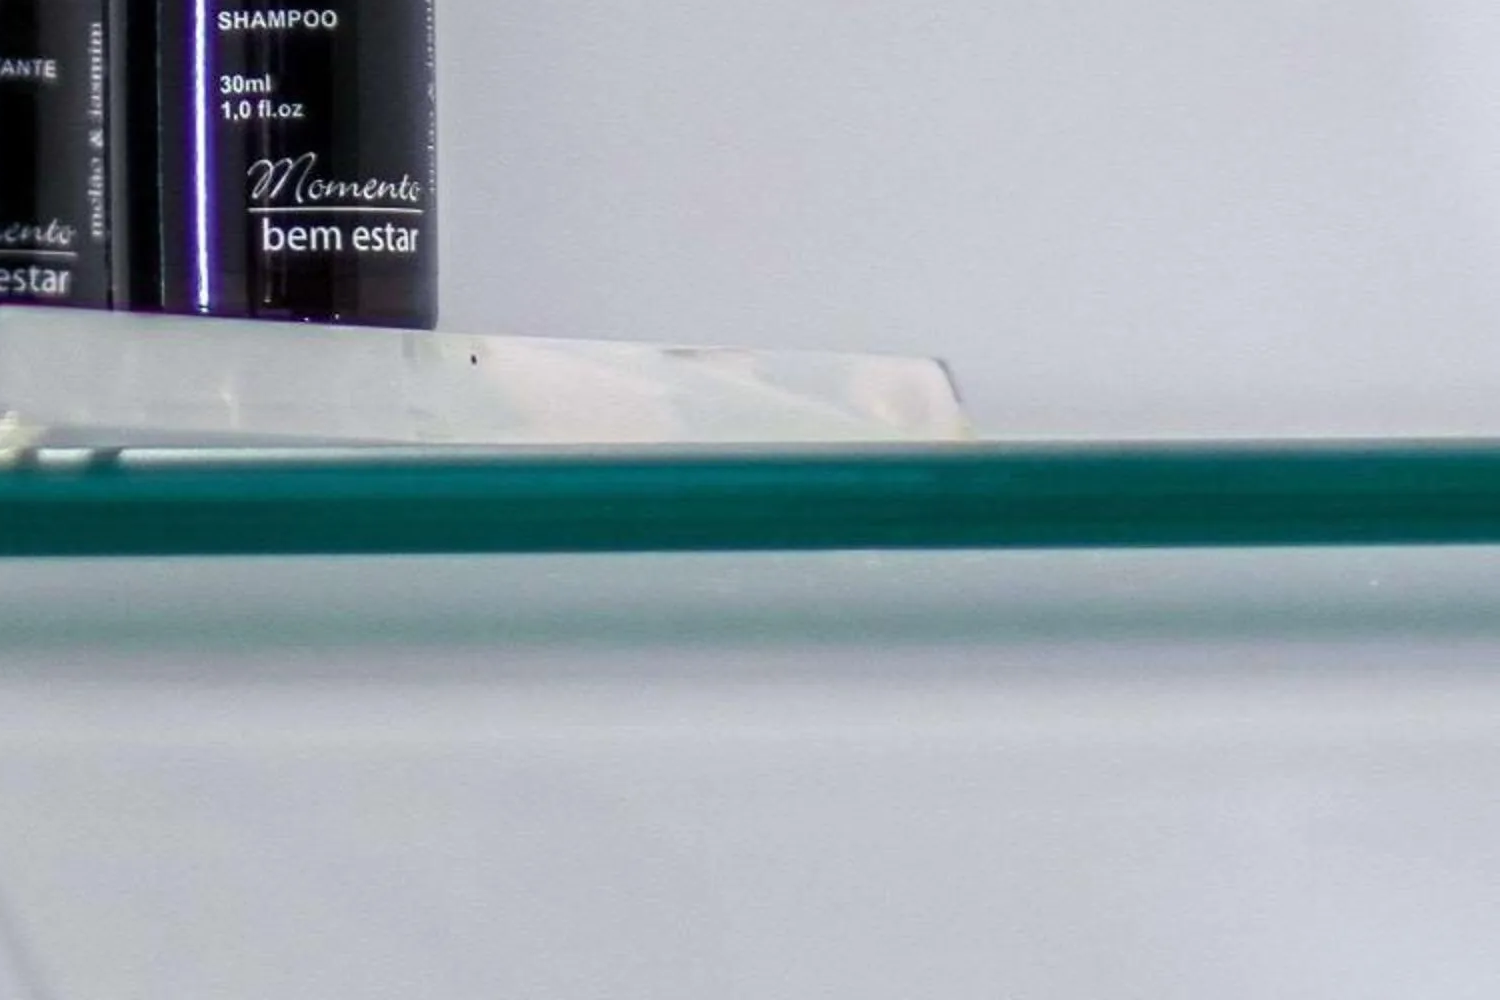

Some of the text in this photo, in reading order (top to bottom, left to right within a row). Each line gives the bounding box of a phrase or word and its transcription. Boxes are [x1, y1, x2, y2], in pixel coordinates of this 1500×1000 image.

[217, 9, 339, 32] SHAMPOO
[219, 75, 272, 95] 30ml
[220, 100, 304, 122] 1,0 fl.oz
[247, 152, 422, 204] Momento
[262, 218, 419, 254] bem estar
